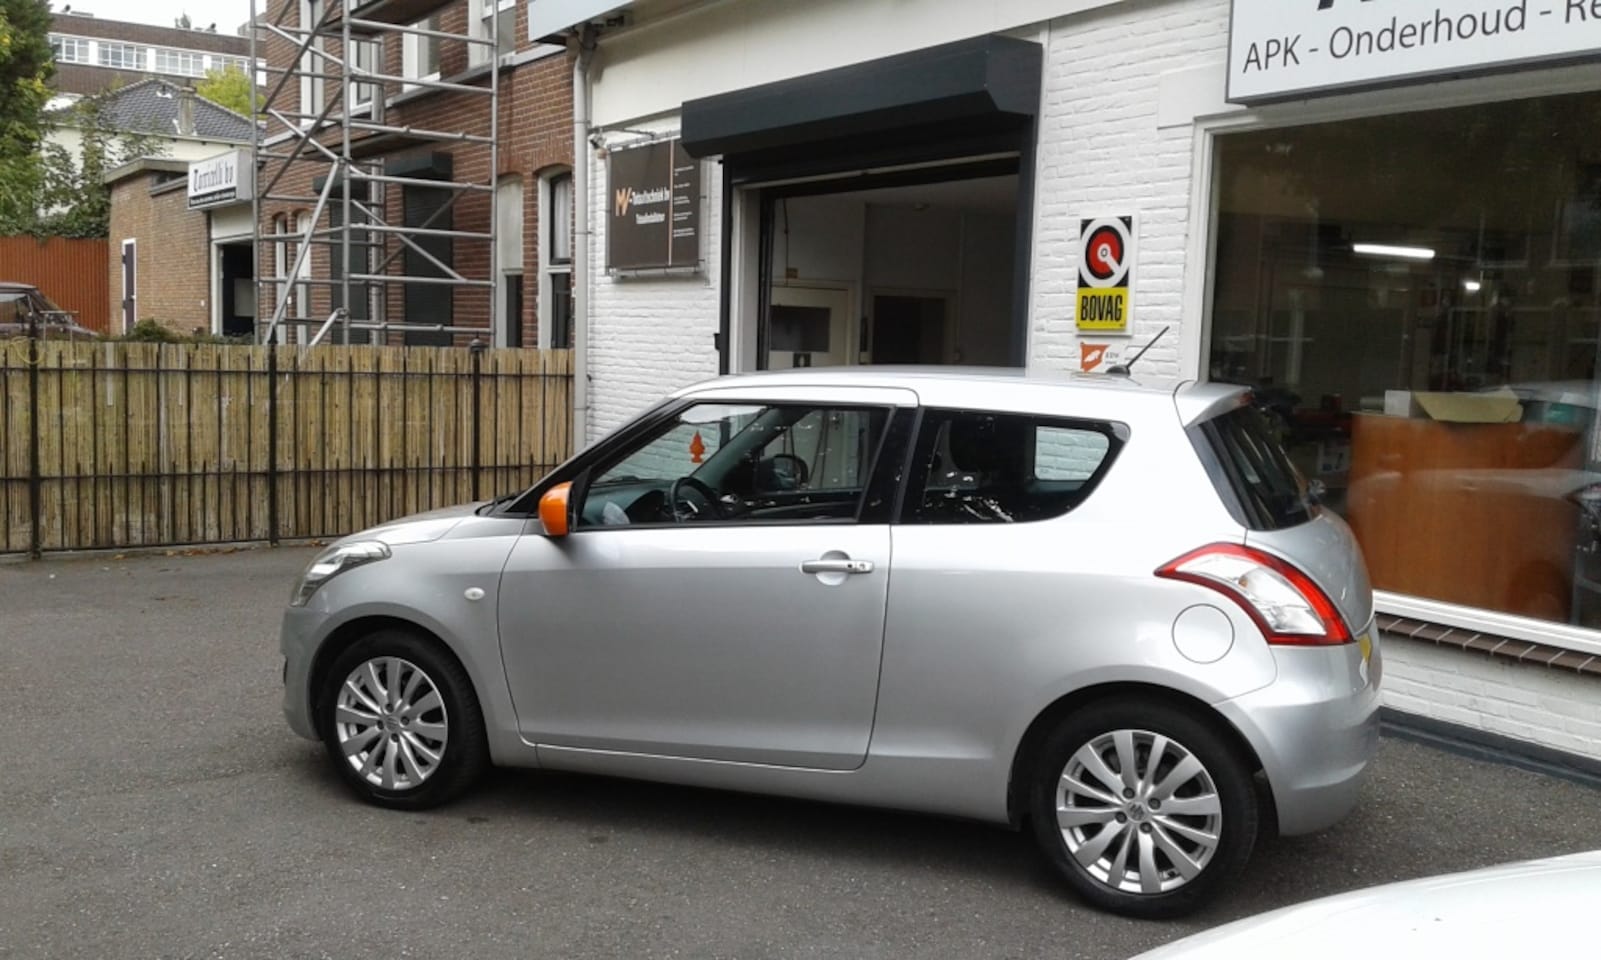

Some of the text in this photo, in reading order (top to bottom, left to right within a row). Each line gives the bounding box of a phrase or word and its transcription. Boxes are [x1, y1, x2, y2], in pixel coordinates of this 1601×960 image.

[1243, 34, 1301, 73] APK
[1329, 0, 1526, 59] Onderhoud
[1080, 294, 1123, 321] BOVAG
